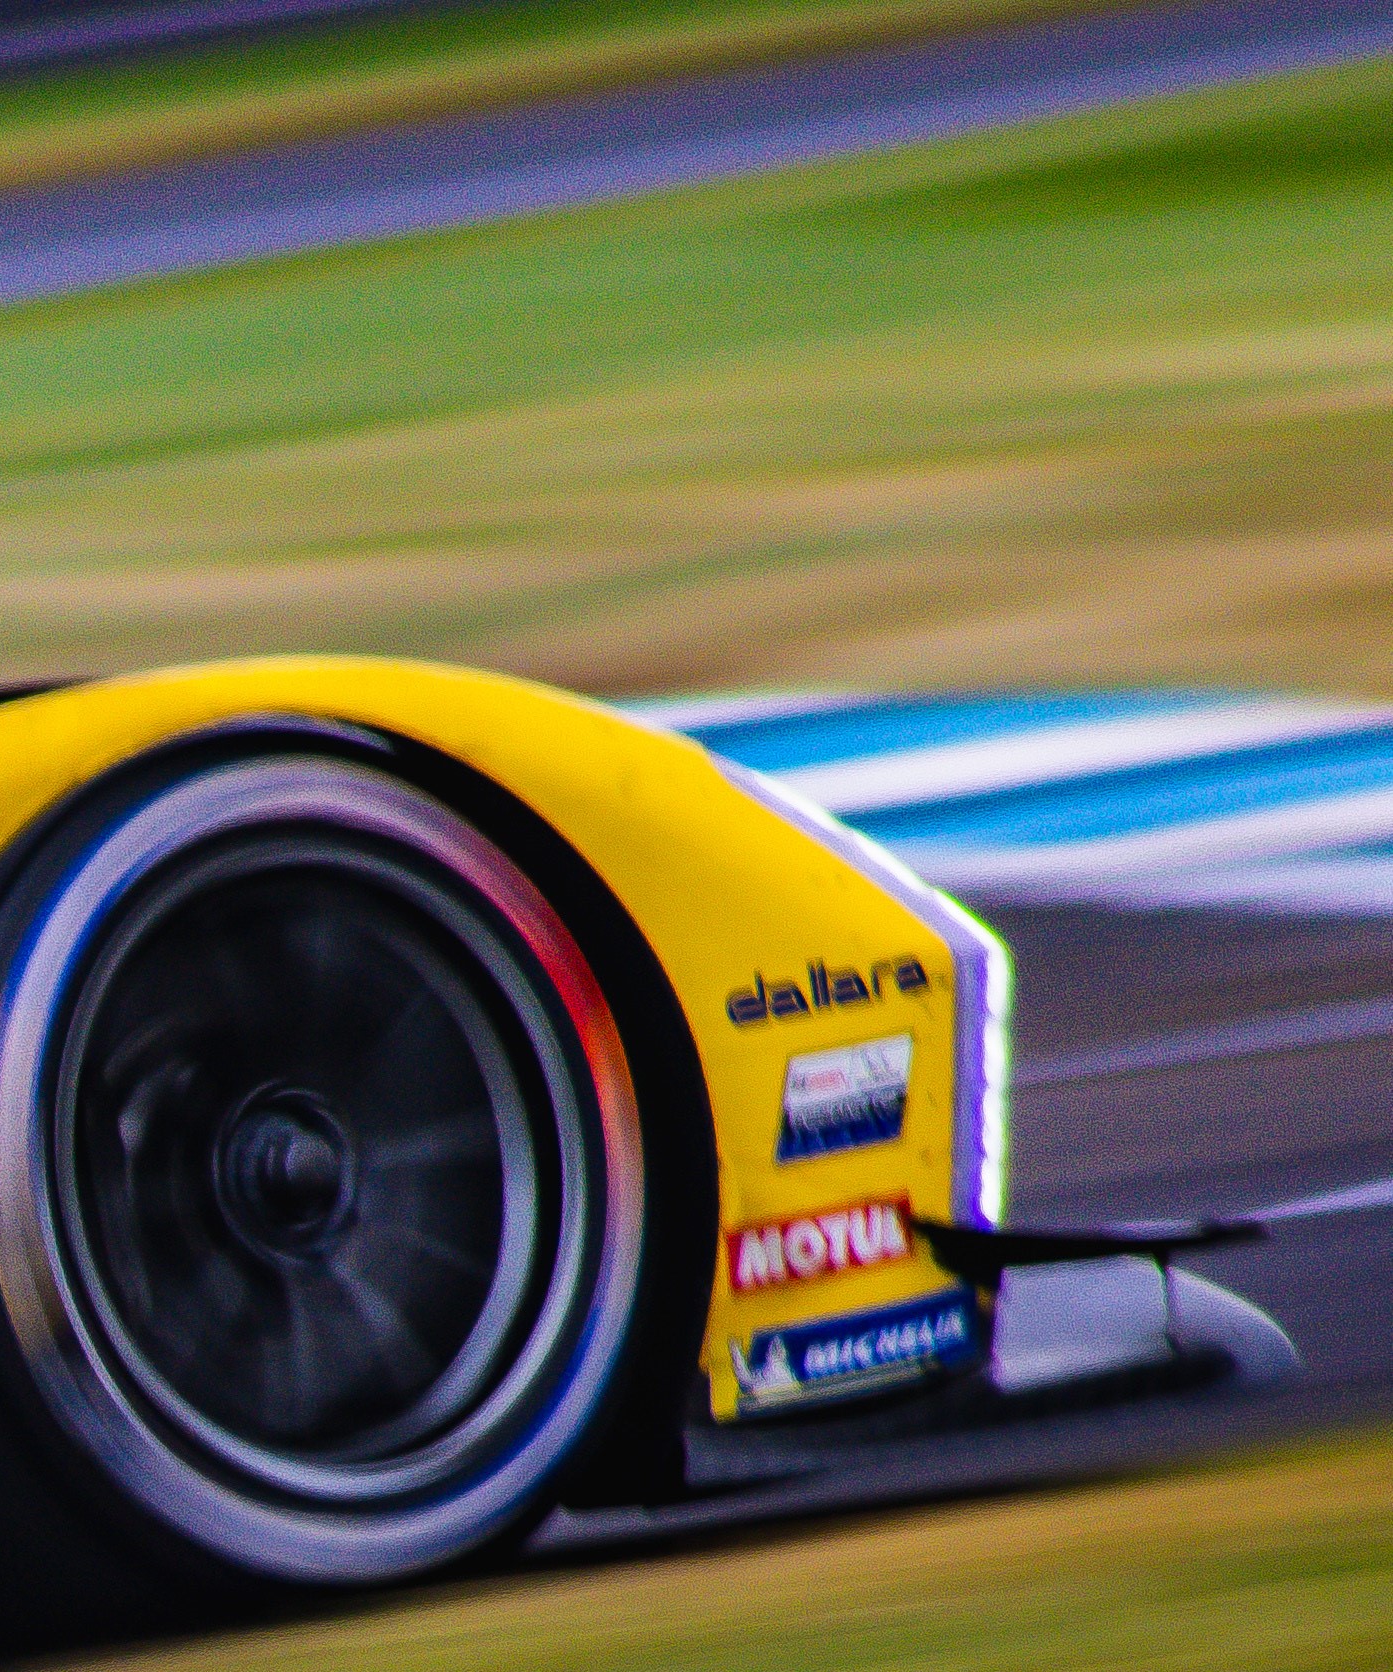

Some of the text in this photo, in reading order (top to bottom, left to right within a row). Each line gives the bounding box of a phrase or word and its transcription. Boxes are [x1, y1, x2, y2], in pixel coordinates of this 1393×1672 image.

[725, 954, 931, 1030] dallara
[736, 1203, 908, 1289] MOTUL
[803, 1304, 966, 1382] MICHELIN
